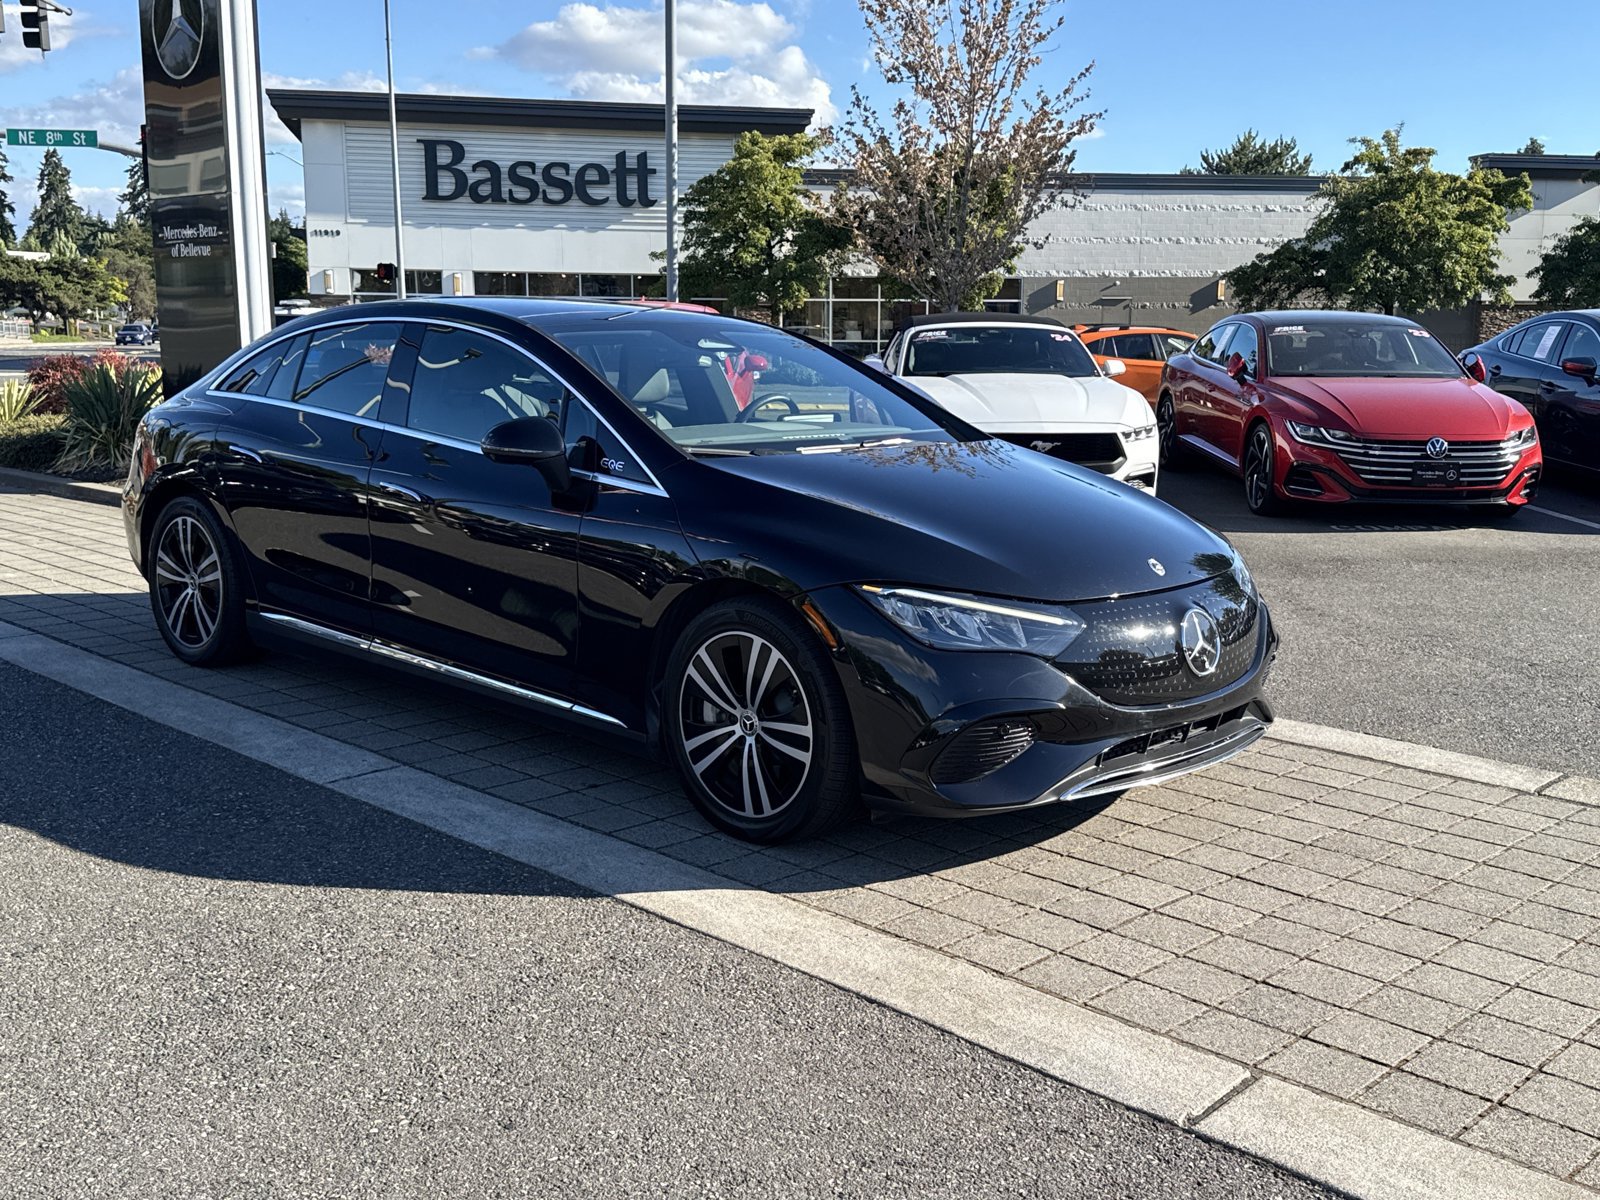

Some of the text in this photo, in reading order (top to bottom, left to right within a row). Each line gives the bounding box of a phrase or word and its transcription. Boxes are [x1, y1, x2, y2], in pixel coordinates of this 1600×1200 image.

[18, 131, 86, 145] NE 8th St
[416, 138, 658, 208] Bassett
[163, 224, 217, 240] Mercedes-Benz
[171, 243, 212, 257] of Bellevue
[600, 457, 625, 471] EQE
